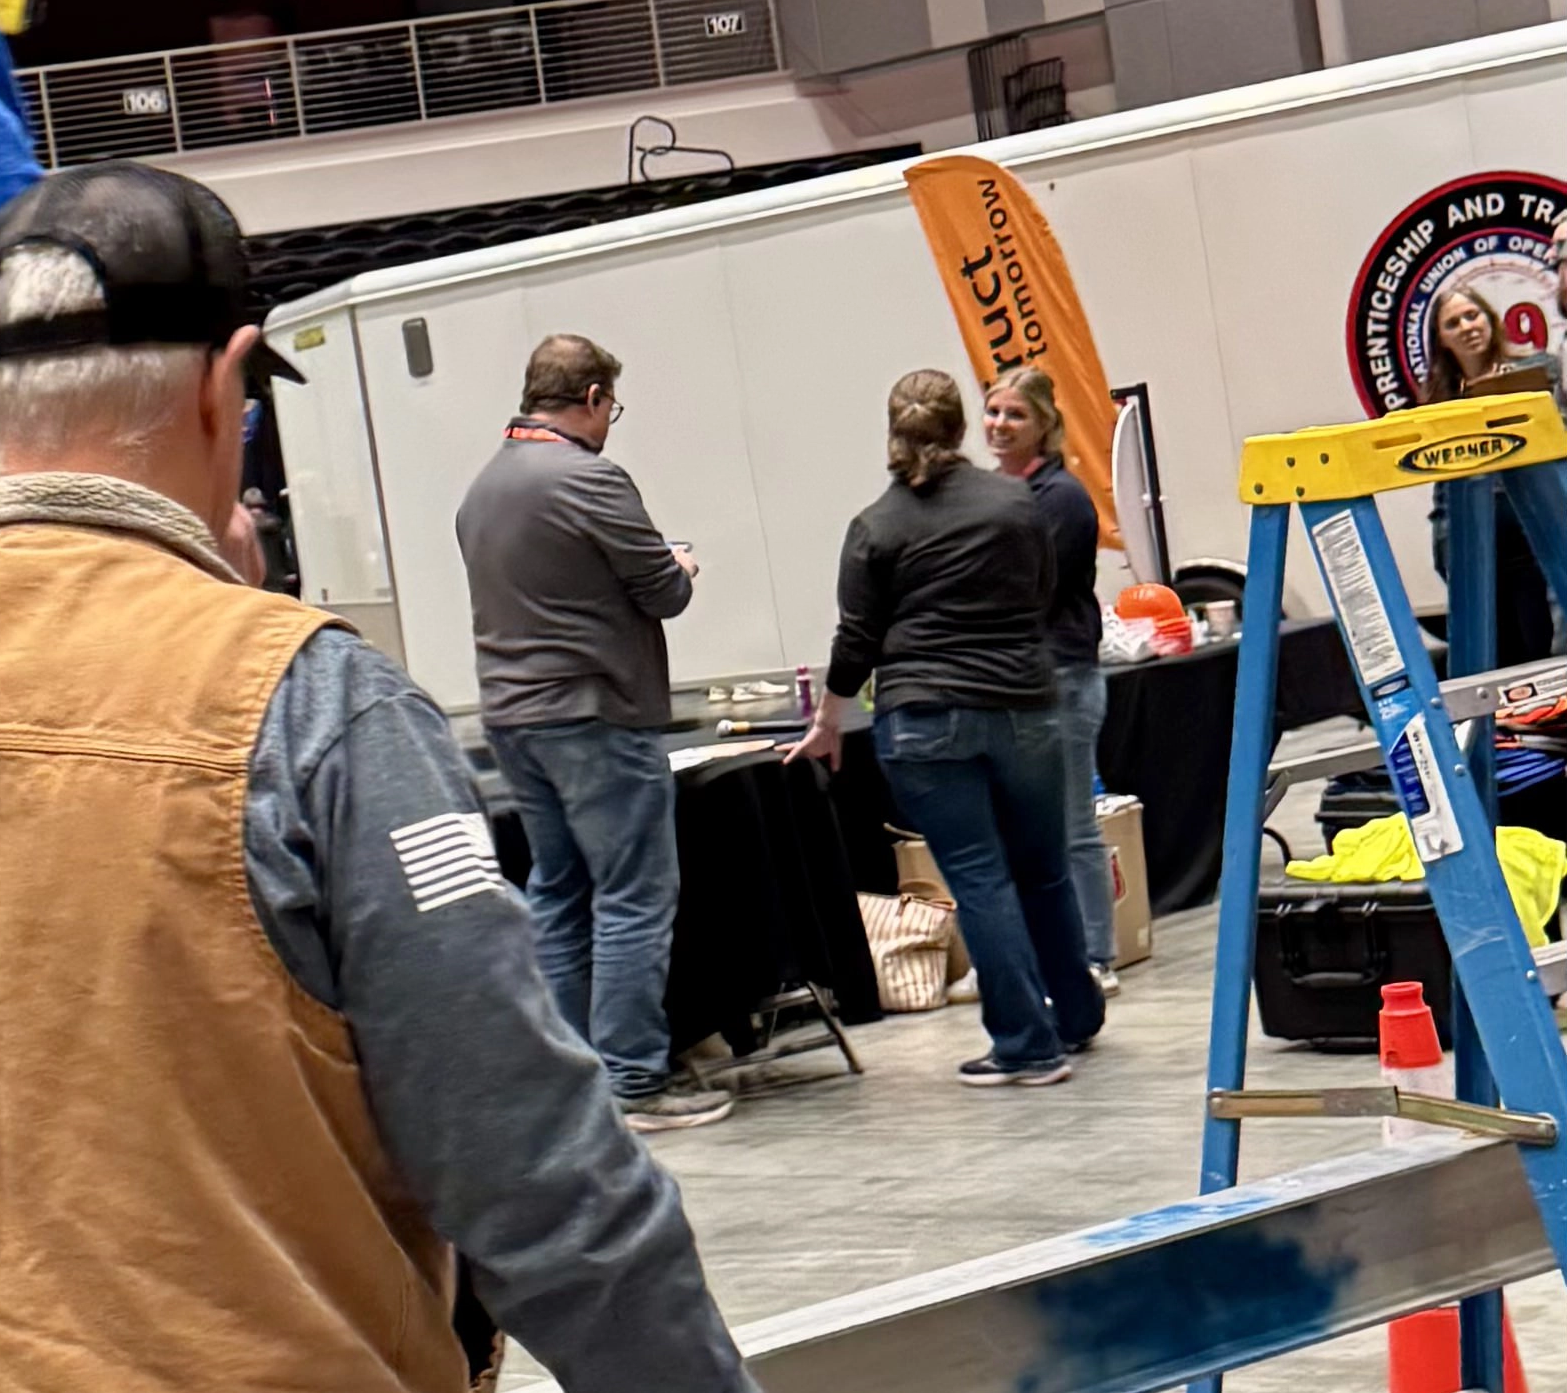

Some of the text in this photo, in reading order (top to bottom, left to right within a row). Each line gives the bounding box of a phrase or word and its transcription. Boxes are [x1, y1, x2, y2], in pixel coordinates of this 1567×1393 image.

[709, 13, 739, 36] 107
[128, 91, 163, 113] 106
[960, 245, 1024, 375] ruct
[977, 178, 1048, 360] tomorrow
[1367, 193, 1567, 411] PRENTICESHIP AND TR
[1419, 246, 1467, 294] UNION
[1474, 234, 1499, 253] OF
[1508, 235, 1547, 258] OPE
